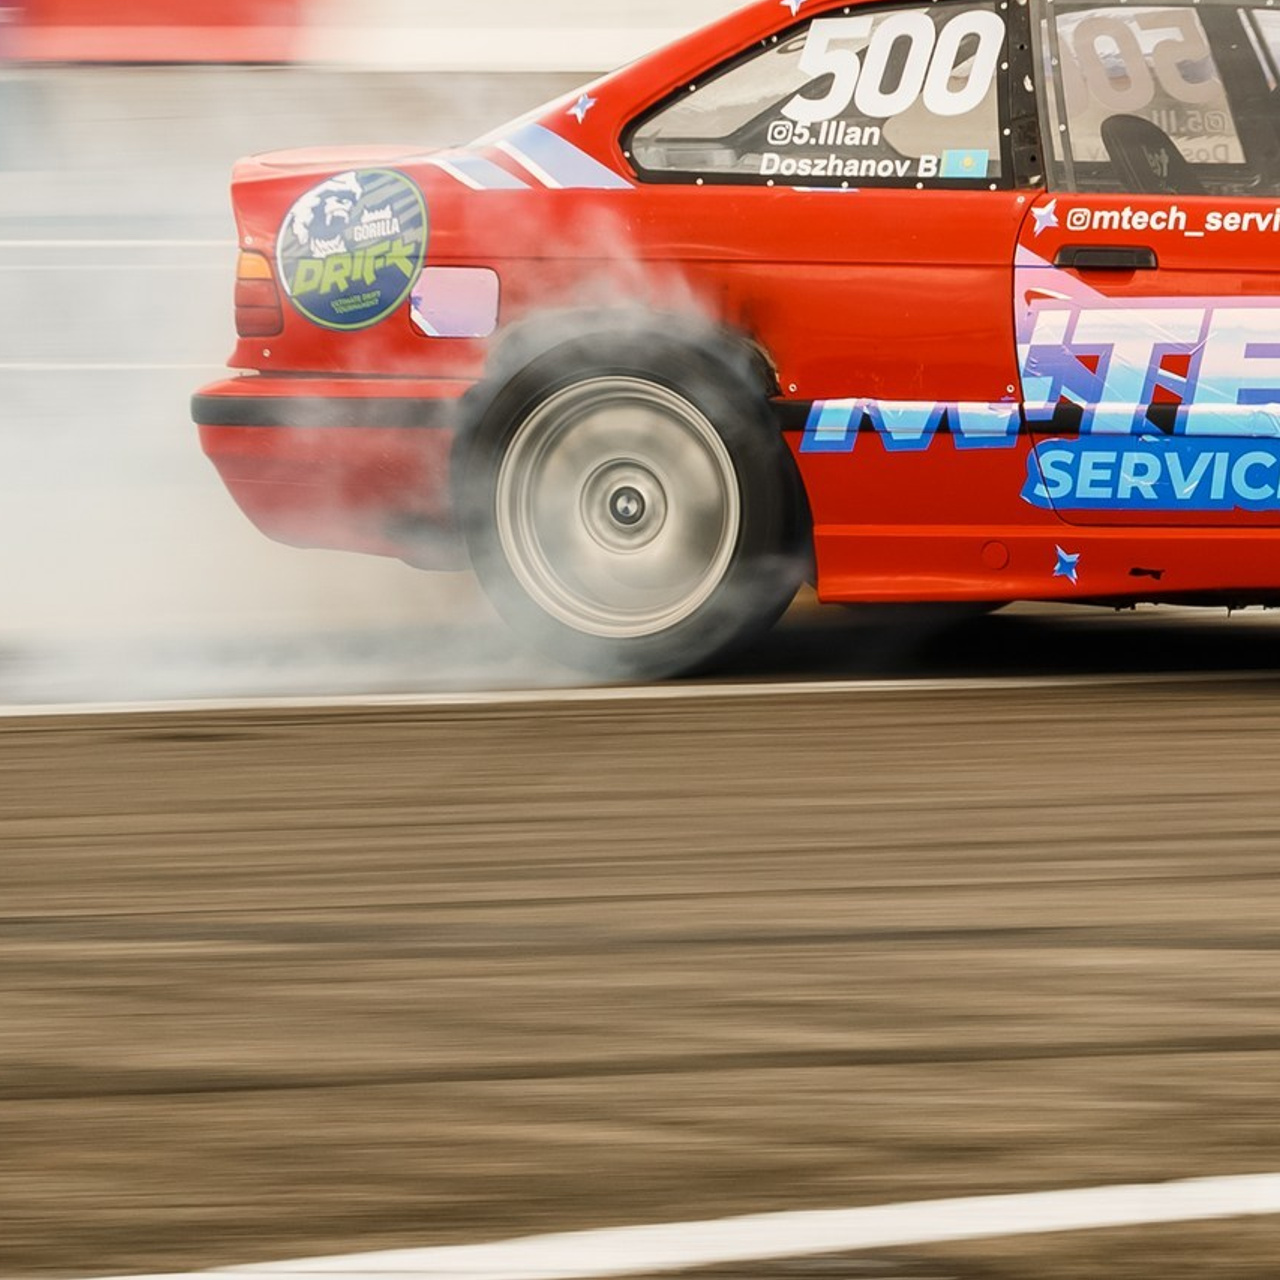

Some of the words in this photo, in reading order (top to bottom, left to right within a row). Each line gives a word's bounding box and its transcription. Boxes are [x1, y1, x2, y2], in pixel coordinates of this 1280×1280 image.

[780, 10, 1006, 122] 500
[759, 153, 911, 177] Doszhanov
[918, 154, 938, 178] B
[354, 218, 401, 241] GORILLA
